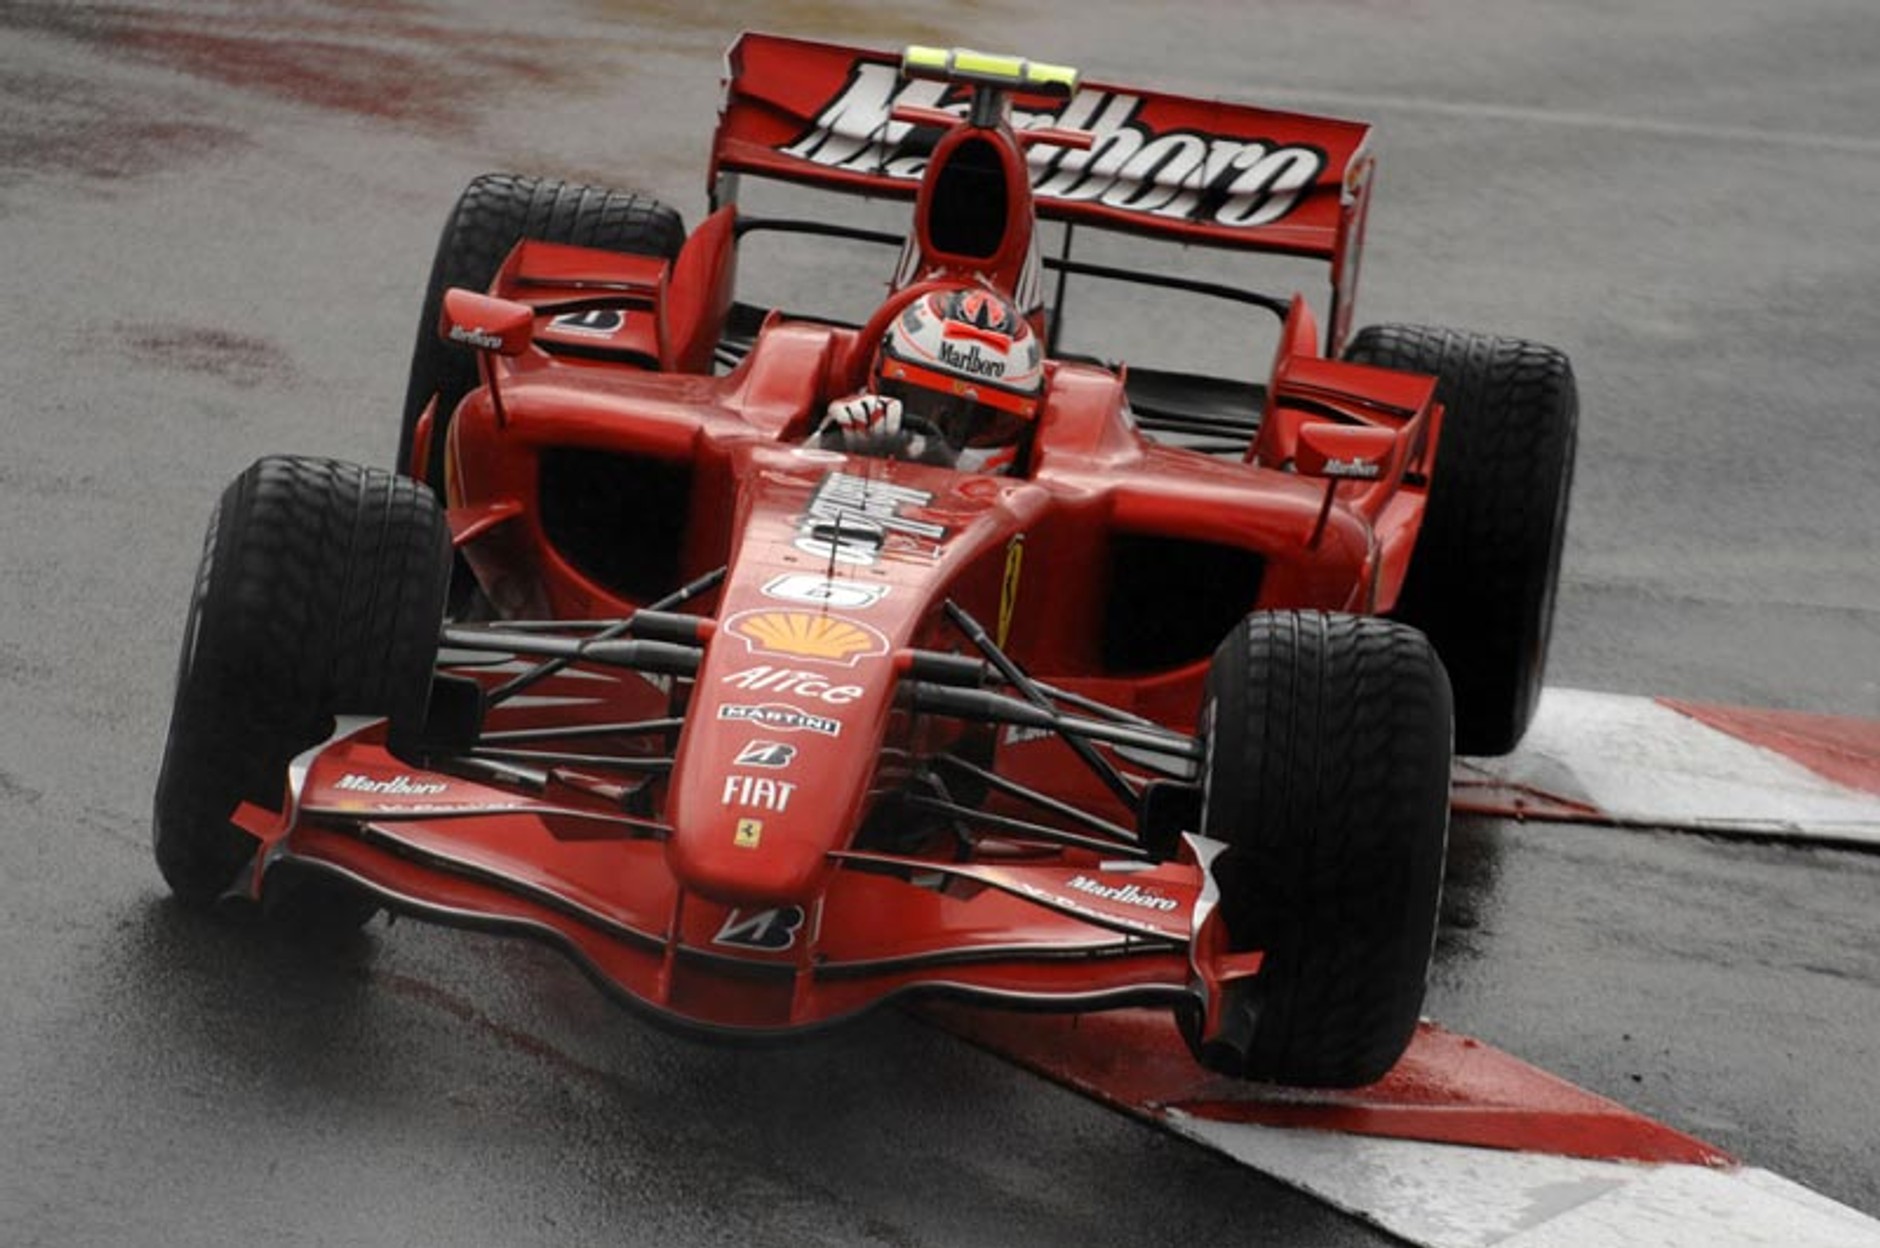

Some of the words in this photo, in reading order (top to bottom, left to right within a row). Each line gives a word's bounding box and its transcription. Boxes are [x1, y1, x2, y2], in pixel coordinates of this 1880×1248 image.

[939, 341, 1005, 377] Marlboro
[722, 665, 865, 704] Alice
[721, 704, 838, 733] MARTINI
[333, 774, 448, 796] Marlboro
[720, 774, 797, 813] FIAT
[1066, 875, 1179, 911] Marlboro
